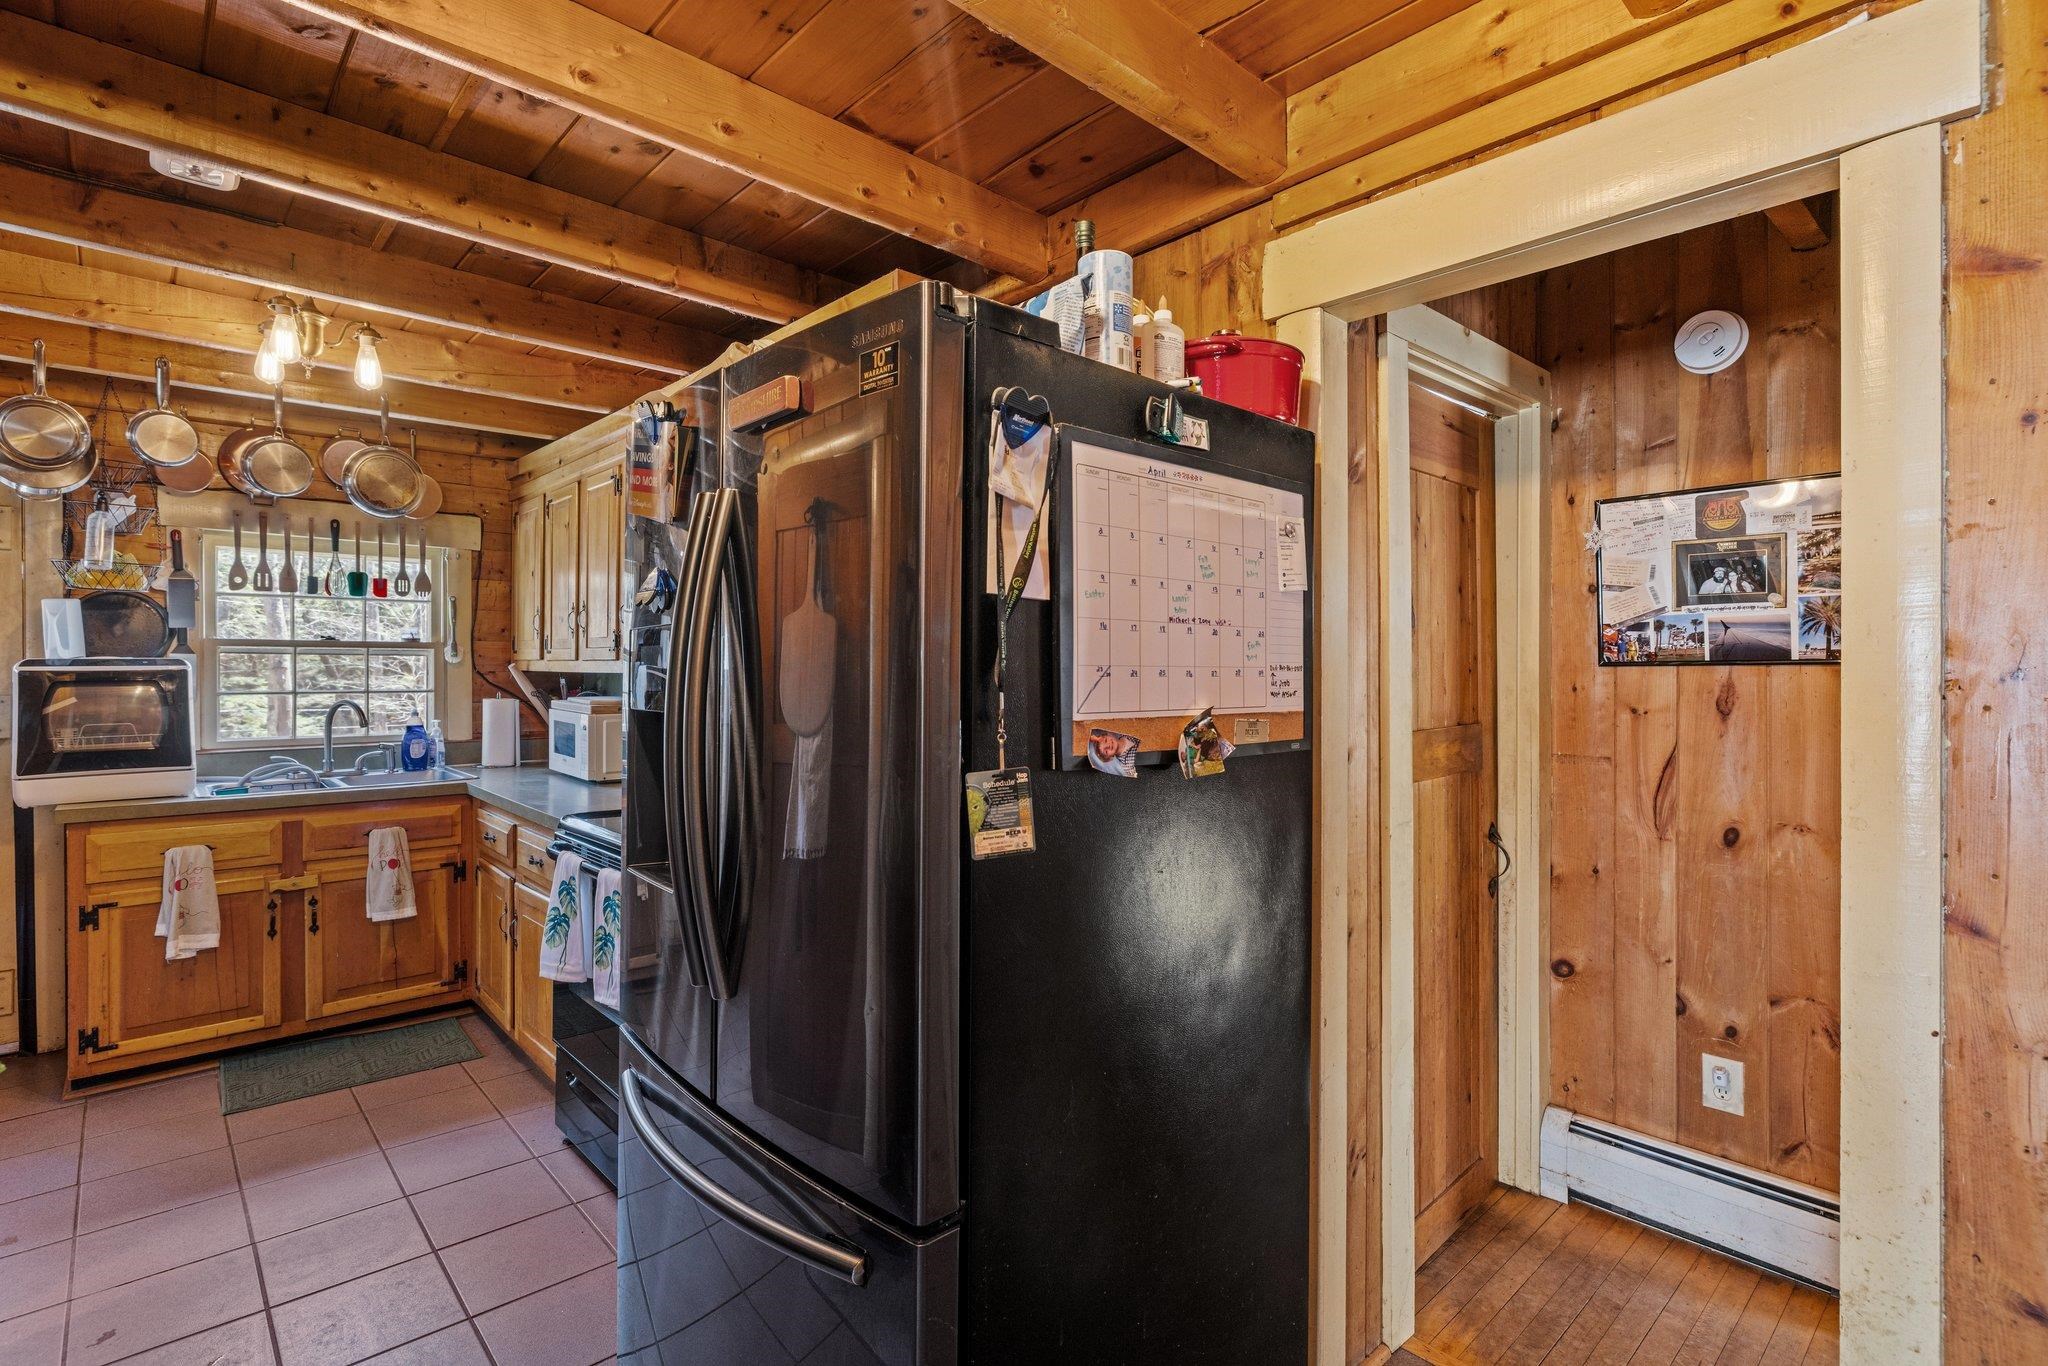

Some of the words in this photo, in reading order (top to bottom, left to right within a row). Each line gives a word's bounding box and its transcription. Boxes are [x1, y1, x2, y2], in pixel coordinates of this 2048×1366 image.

[851, 319, 904, 348] SAMSUNG
[872, 348, 886, 368] 10
[863, 363, 894, 379] WARRANTY
[1147, 465, 1167, 478] April
[1169, 616, 1190, 624] Michael
[982, 779, 1015, 789] Schedule
